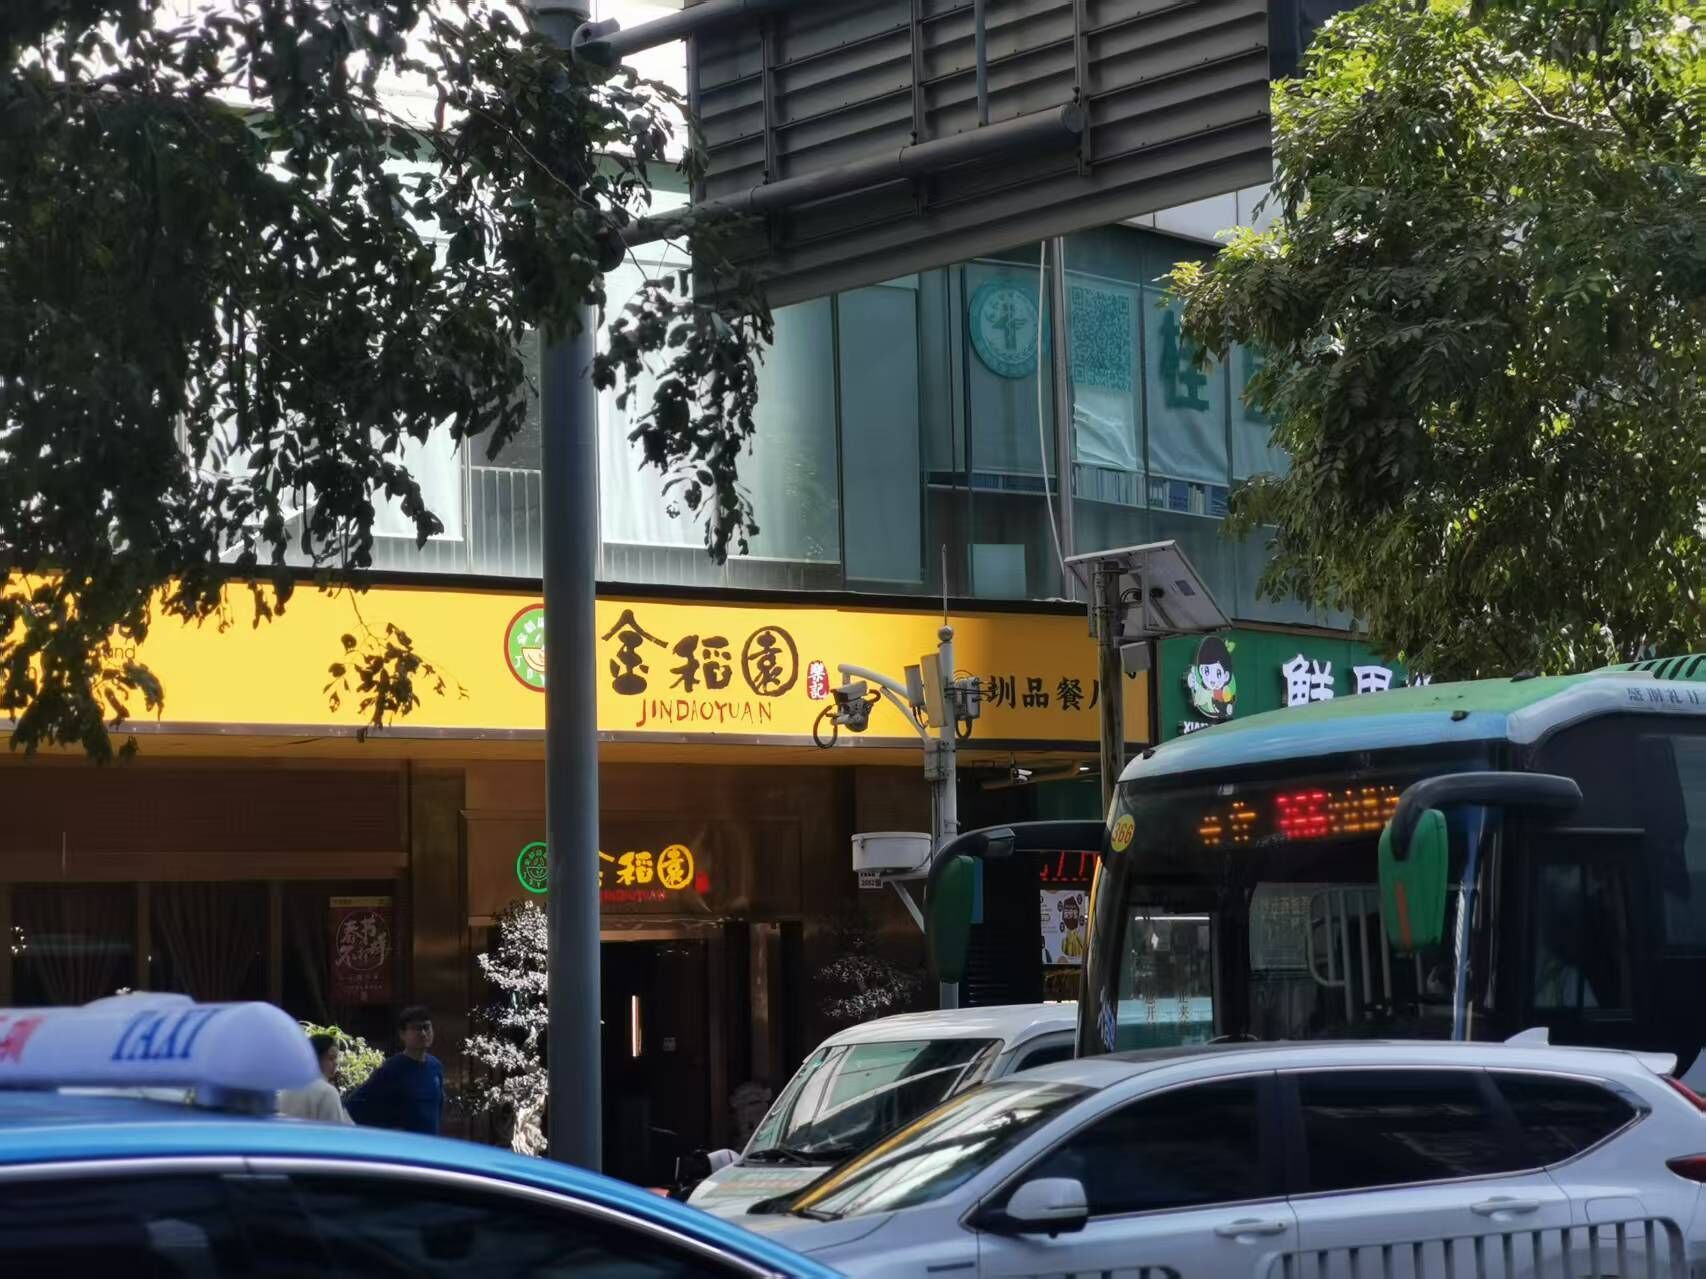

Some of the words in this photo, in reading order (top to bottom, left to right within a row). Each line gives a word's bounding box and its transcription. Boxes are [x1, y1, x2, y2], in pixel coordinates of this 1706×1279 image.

[636, 699, 772, 728] JINDAOYUAN
[1111, 822, 1134, 844] 366
[110, 1008, 222, 1061] TAXI
